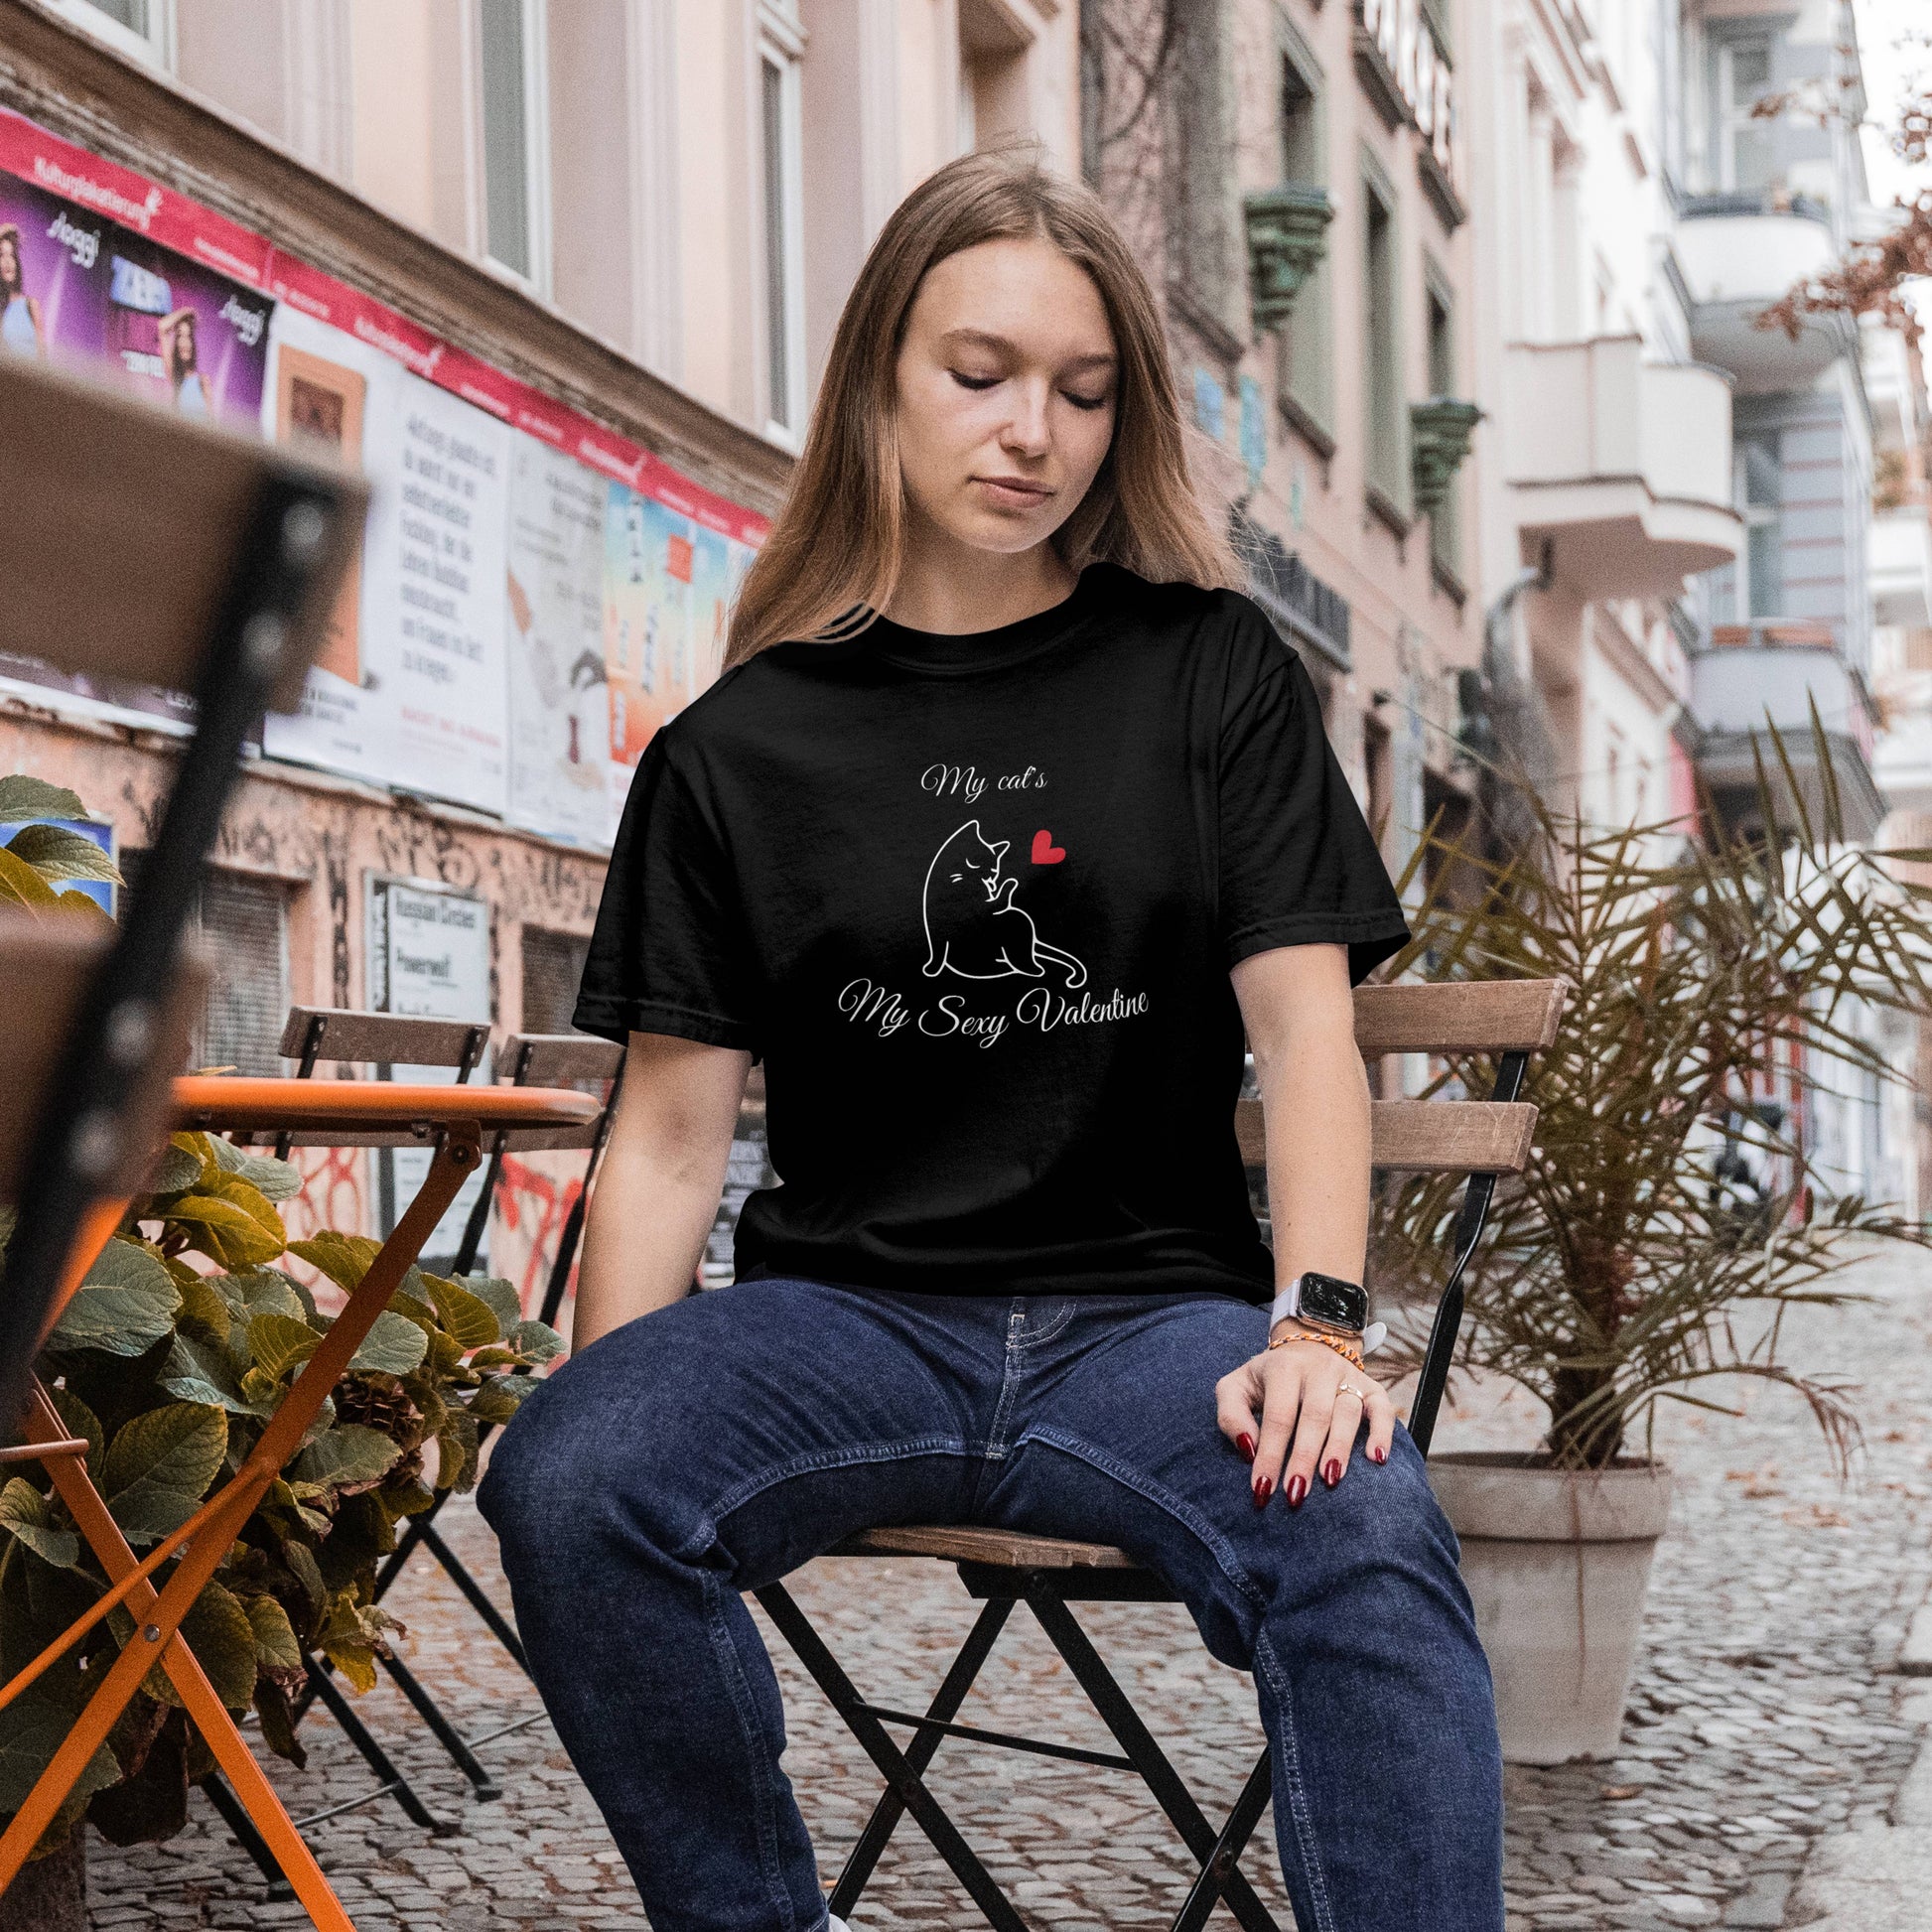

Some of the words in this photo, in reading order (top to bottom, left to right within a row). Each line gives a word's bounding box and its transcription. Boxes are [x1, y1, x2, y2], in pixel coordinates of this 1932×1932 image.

[921, 763, 988, 803] My
[997, 765, 1048, 790] cat's
[838, 978, 910, 1037] My
[917, 995, 1010, 1049] Sexy
[1016, 988, 1149, 1033] Valentine
